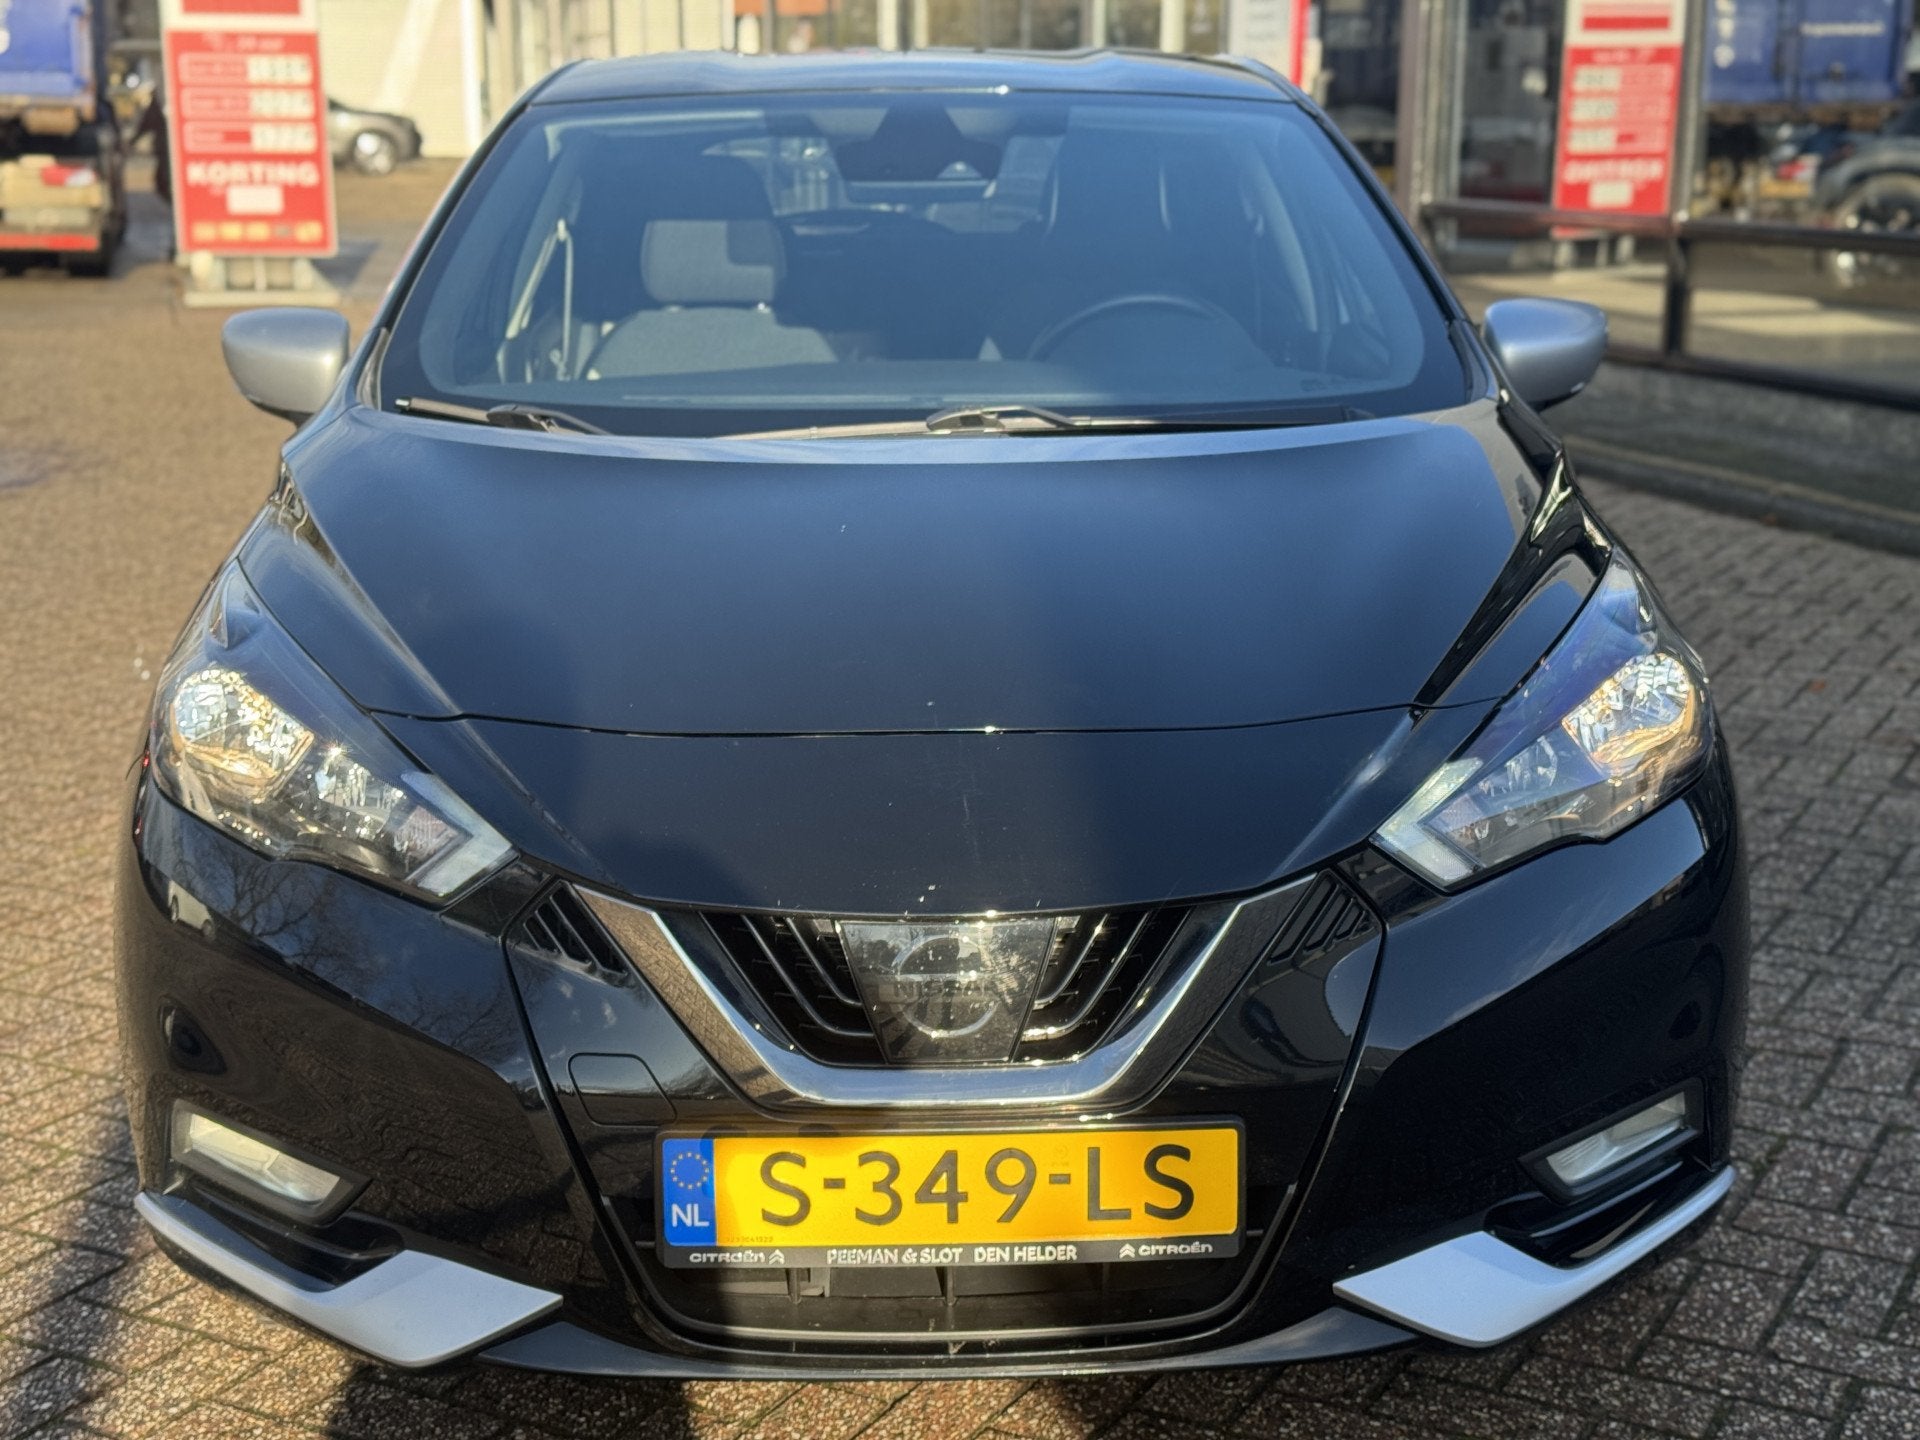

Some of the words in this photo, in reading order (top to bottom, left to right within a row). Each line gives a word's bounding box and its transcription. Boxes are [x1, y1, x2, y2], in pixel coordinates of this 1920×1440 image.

[760, 1143, 1195, 1227] S-349-LS
[671, 1203, 710, 1228] NL
[826, 1249, 898, 1265] PEEMAN
[901, 1248, 917, 1263] &
[919, 1247, 963, 1264] SLOT
[973, 1246, 1010, 1263] DEN
[1013, 1244, 1077, 1262] HELDER
